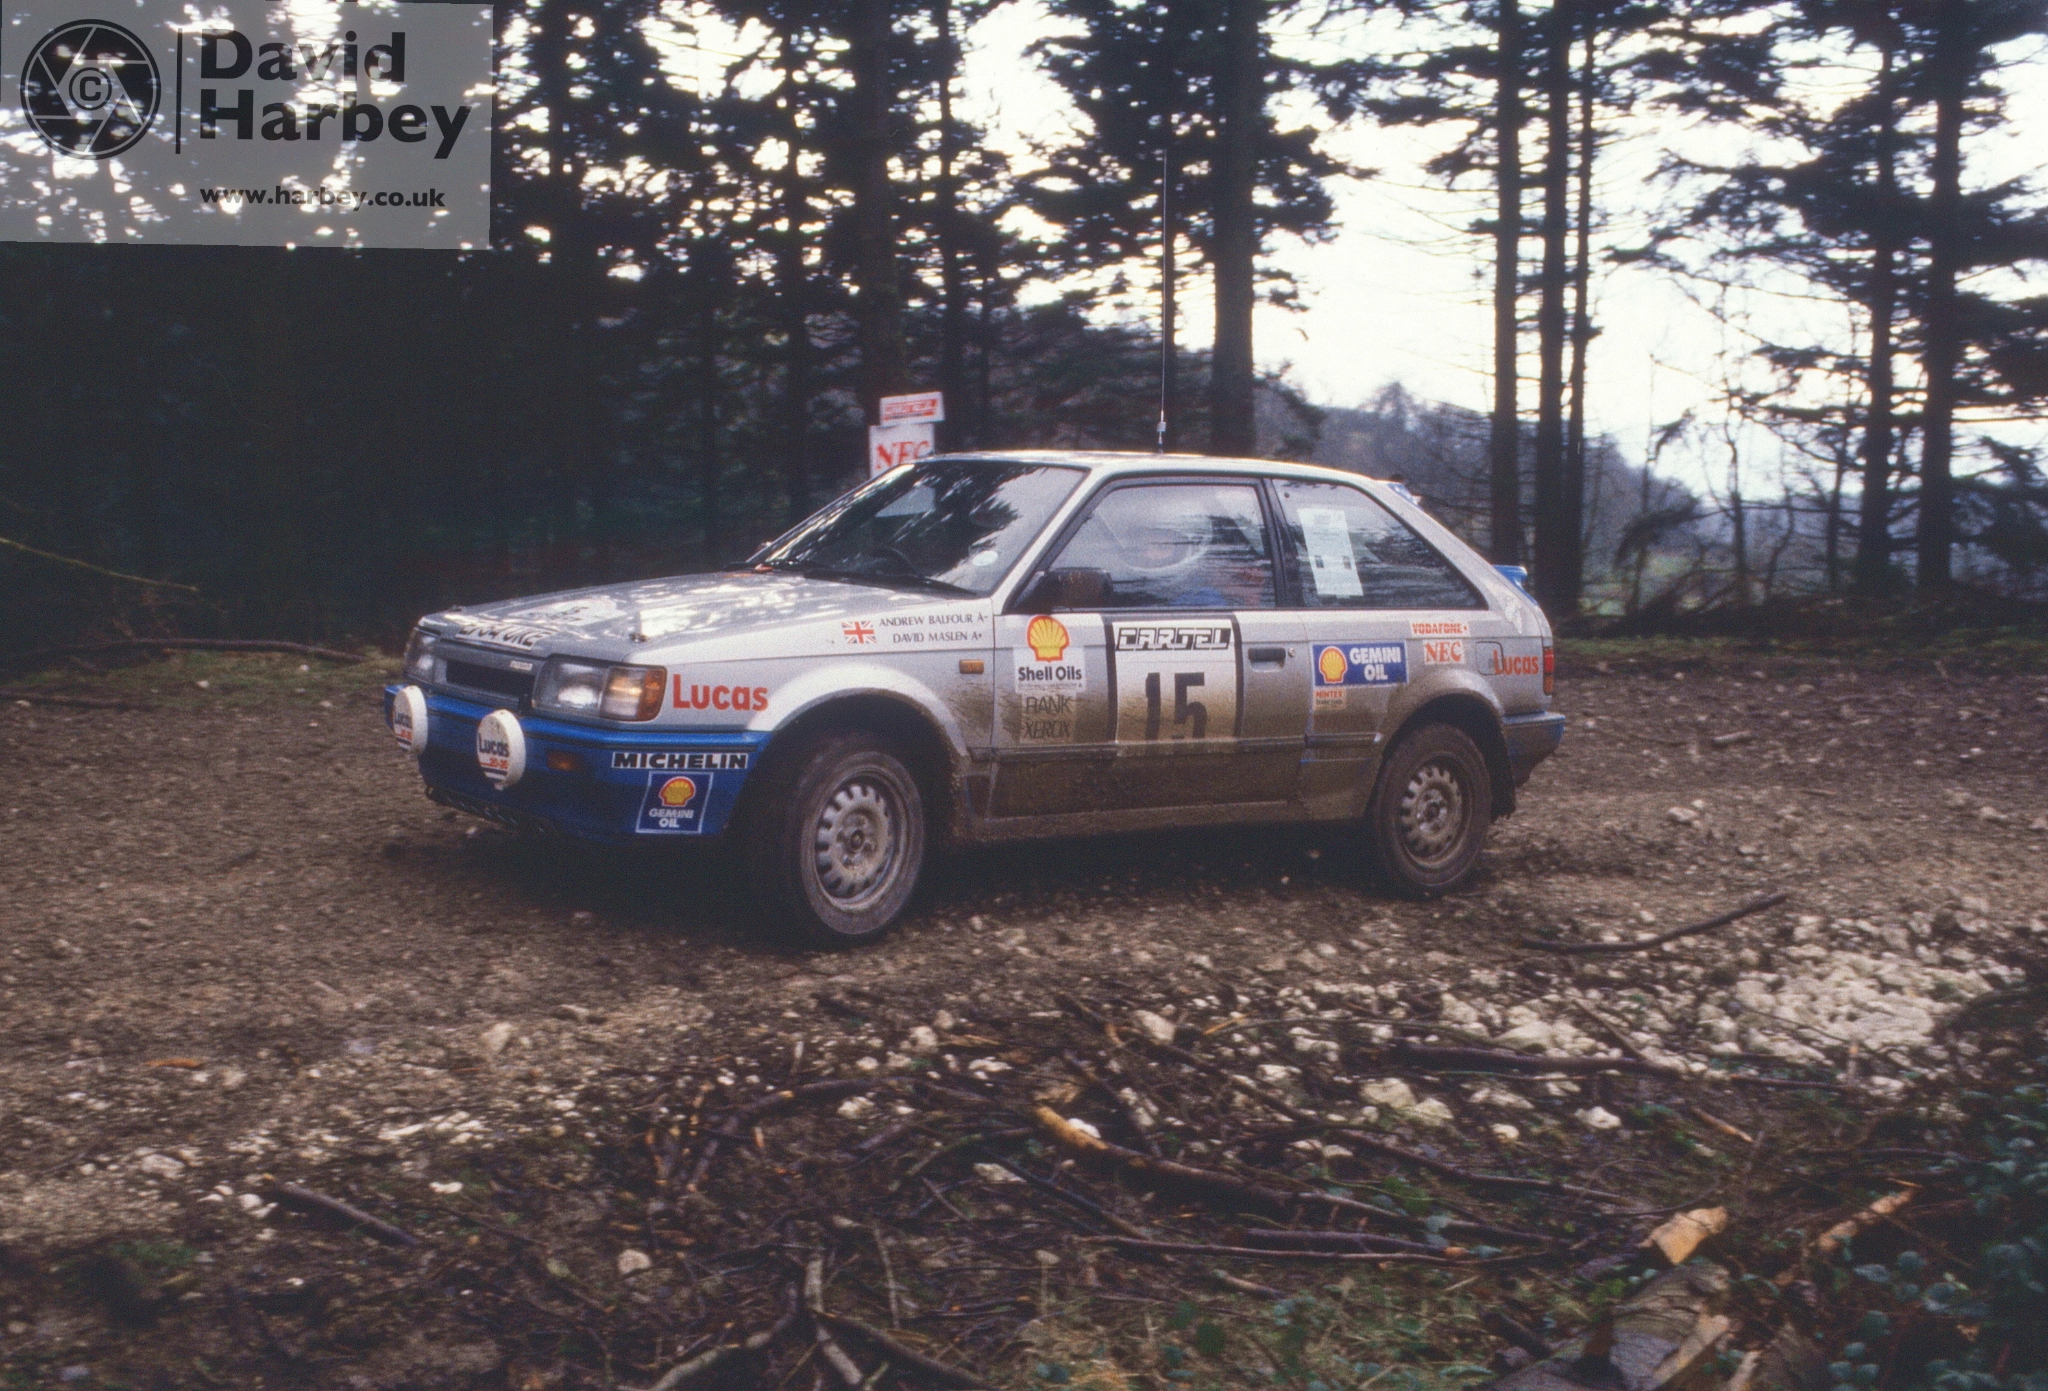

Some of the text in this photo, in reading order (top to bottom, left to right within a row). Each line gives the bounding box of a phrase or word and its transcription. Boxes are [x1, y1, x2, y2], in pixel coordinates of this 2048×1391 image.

[879, 616, 925, 627] ANDREW
[929, 614, 973, 625] BALFOUR
[893, 632, 925, 643] DAVID
[929, 631, 968, 642] MASLEN
[1116, 627, 1231, 651] CARTEL
[1349, 646, 1402, 665] GEMINI
[1425, 641, 1462, 662] NEC
[1493, 649, 1539, 675] Lucas
[1018, 666, 1082, 681] Shell Oils
[1364, 663, 1389, 681] OIL
[672, 673, 769, 712] Lucas
[1026, 694, 1072, 714] RANK
[1145, 672, 1208, 740] 15
[614, 753, 748, 769] MICHELIN
[649, 808, 694, 819] GEMINI
[659, 818, 680, 828] OIL
